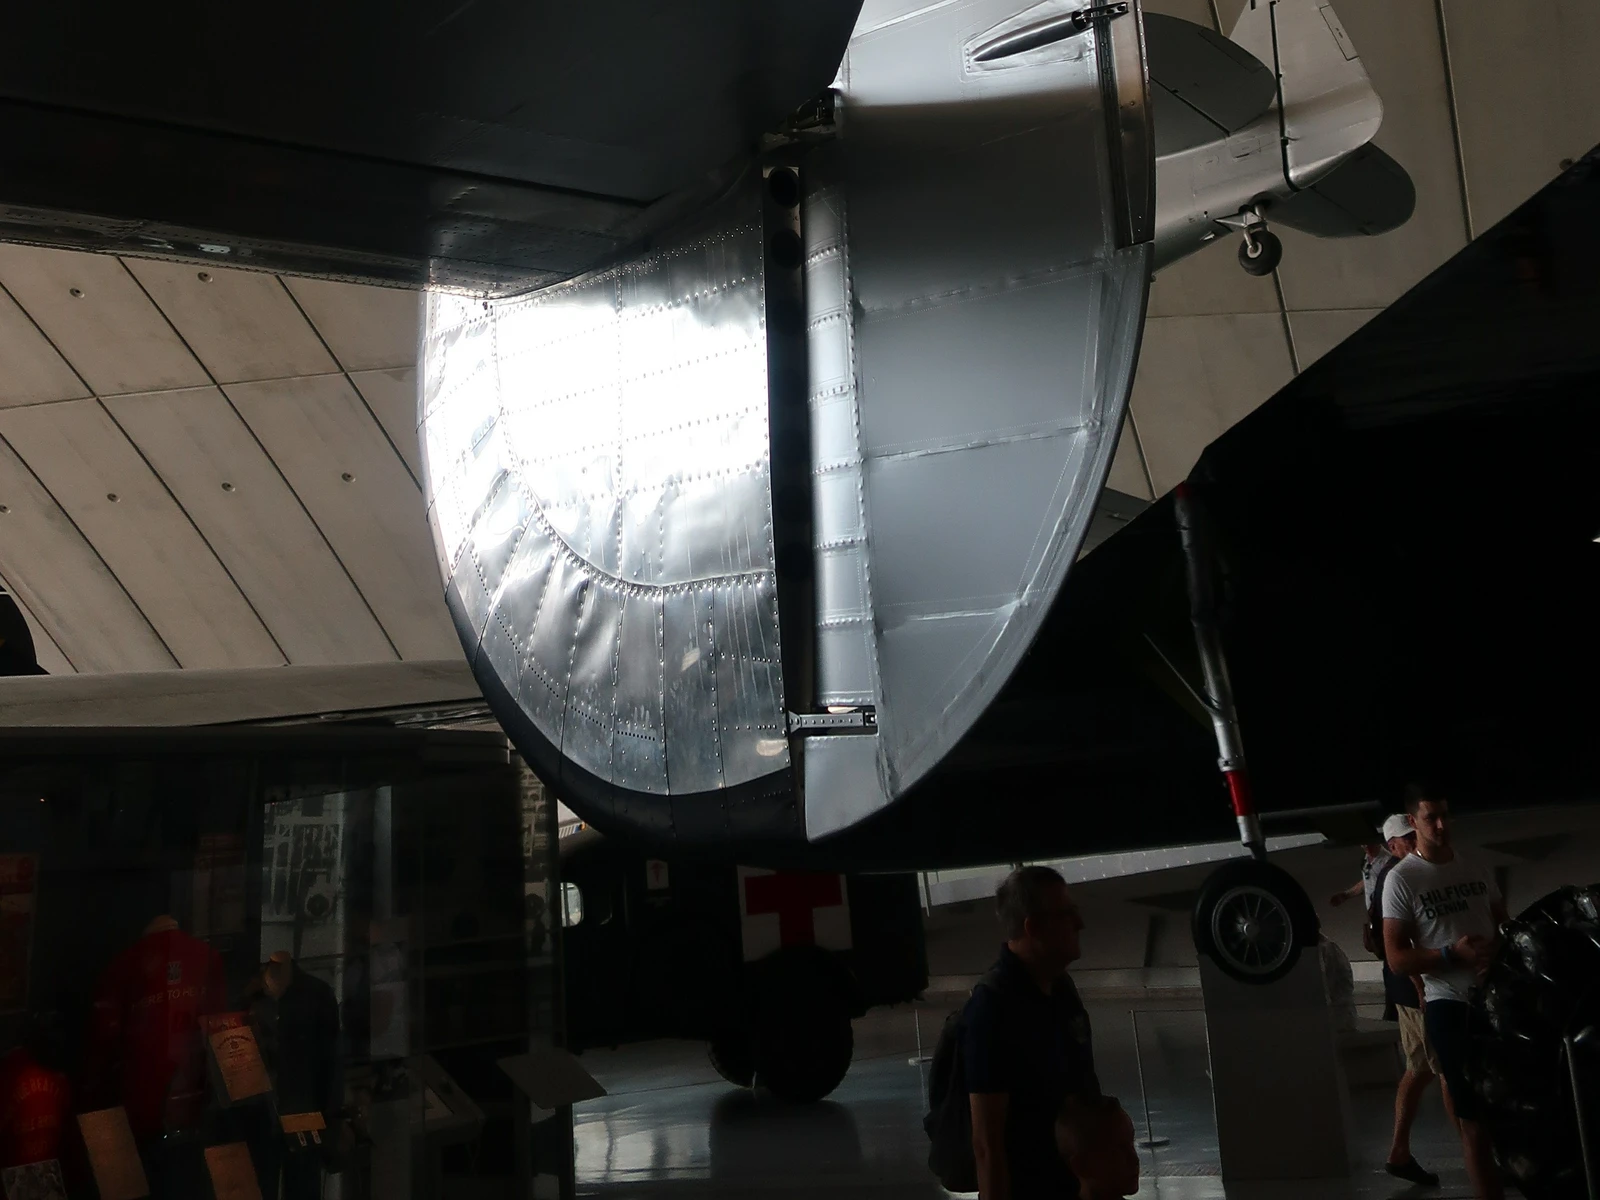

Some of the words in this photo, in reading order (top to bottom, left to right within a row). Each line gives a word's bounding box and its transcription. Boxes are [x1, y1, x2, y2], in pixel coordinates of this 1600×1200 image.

[1420, 882, 1487, 906] HILFIGER
[1426, 900, 1468, 919] DENIM
[167, 989, 181, 1000] TO
[182, 984, 207, 997] HEP
